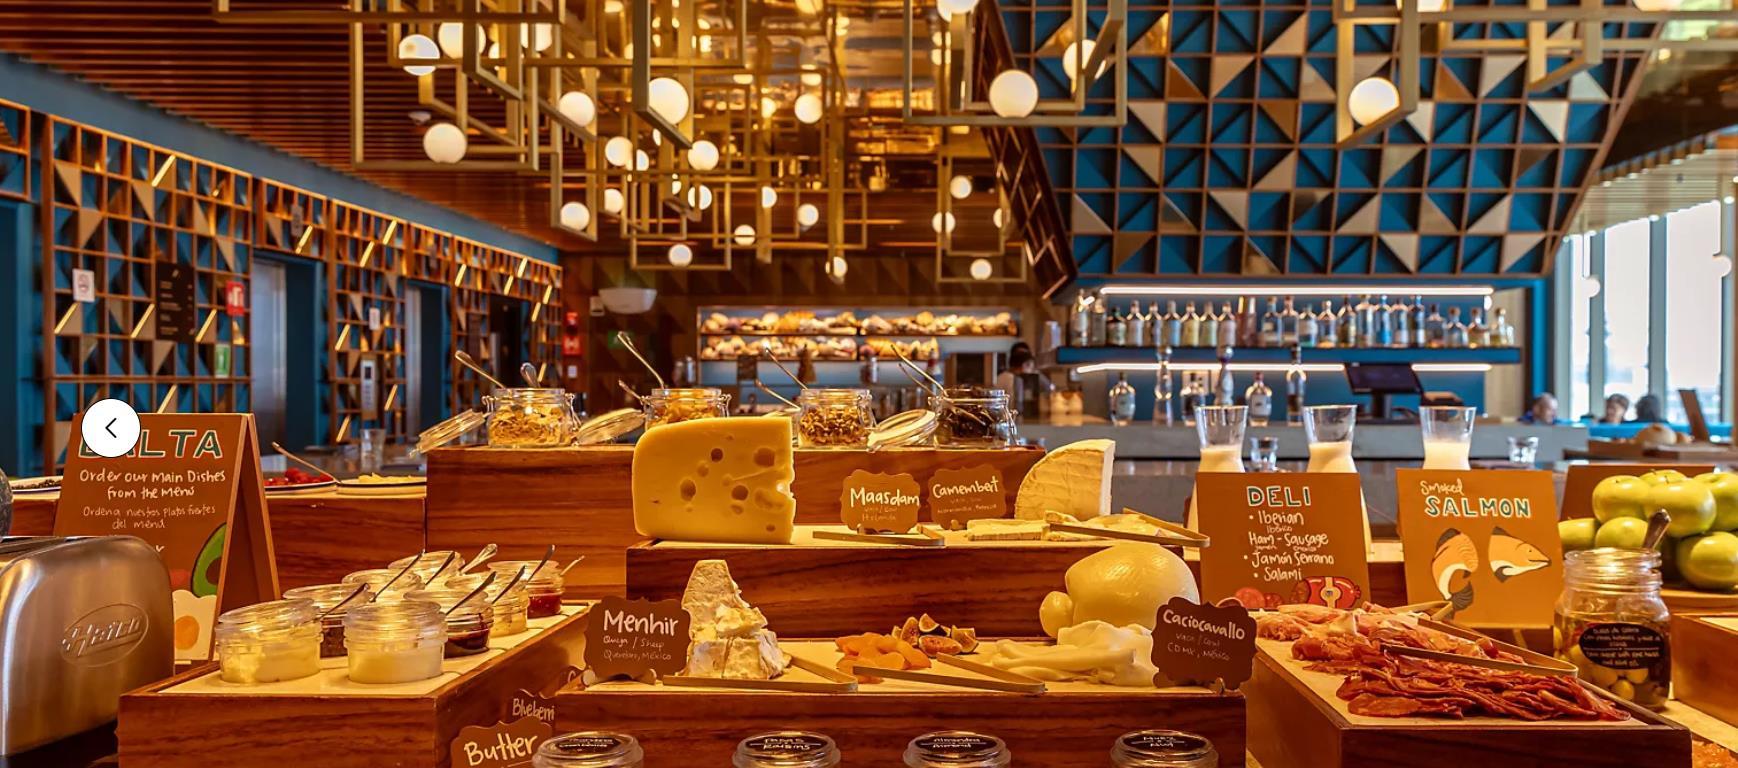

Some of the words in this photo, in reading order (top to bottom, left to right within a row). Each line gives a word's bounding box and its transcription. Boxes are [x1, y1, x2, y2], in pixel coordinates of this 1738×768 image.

[78, 429, 223, 459] LTA
[79, 467, 122, 482] Order
[124, 472, 149, 483] our
[187, 470, 226, 482] Dishes
[107, 486, 136, 500] from
[140, 487, 158, 499] the
[932, 475, 999, 498] Camembert
[1420, 478, 1464, 495] Smoked
[850, 486, 920, 508] Maasdam
[1246, 485, 1311, 507] DELI
[83, 506, 121, 517] Ordena
[1424, 495, 1531, 518] SALMON
[112, 518, 127, 530] del
[1258, 510, 1304, 526] Iberian
[1248, 531, 1275, 546] Ham
[1284, 532, 1329, 548] Sausage
[1251, 551, 1293, 568] Jamón
[1293, 551, 1335, 568] Serrano
[1263, 568, 1302, 582] Salami
[603, 609, 679, 637] Menhir
[1163, 608, 1245, 640] Caciocavallo
[464, 733, 538, 767] Butter
